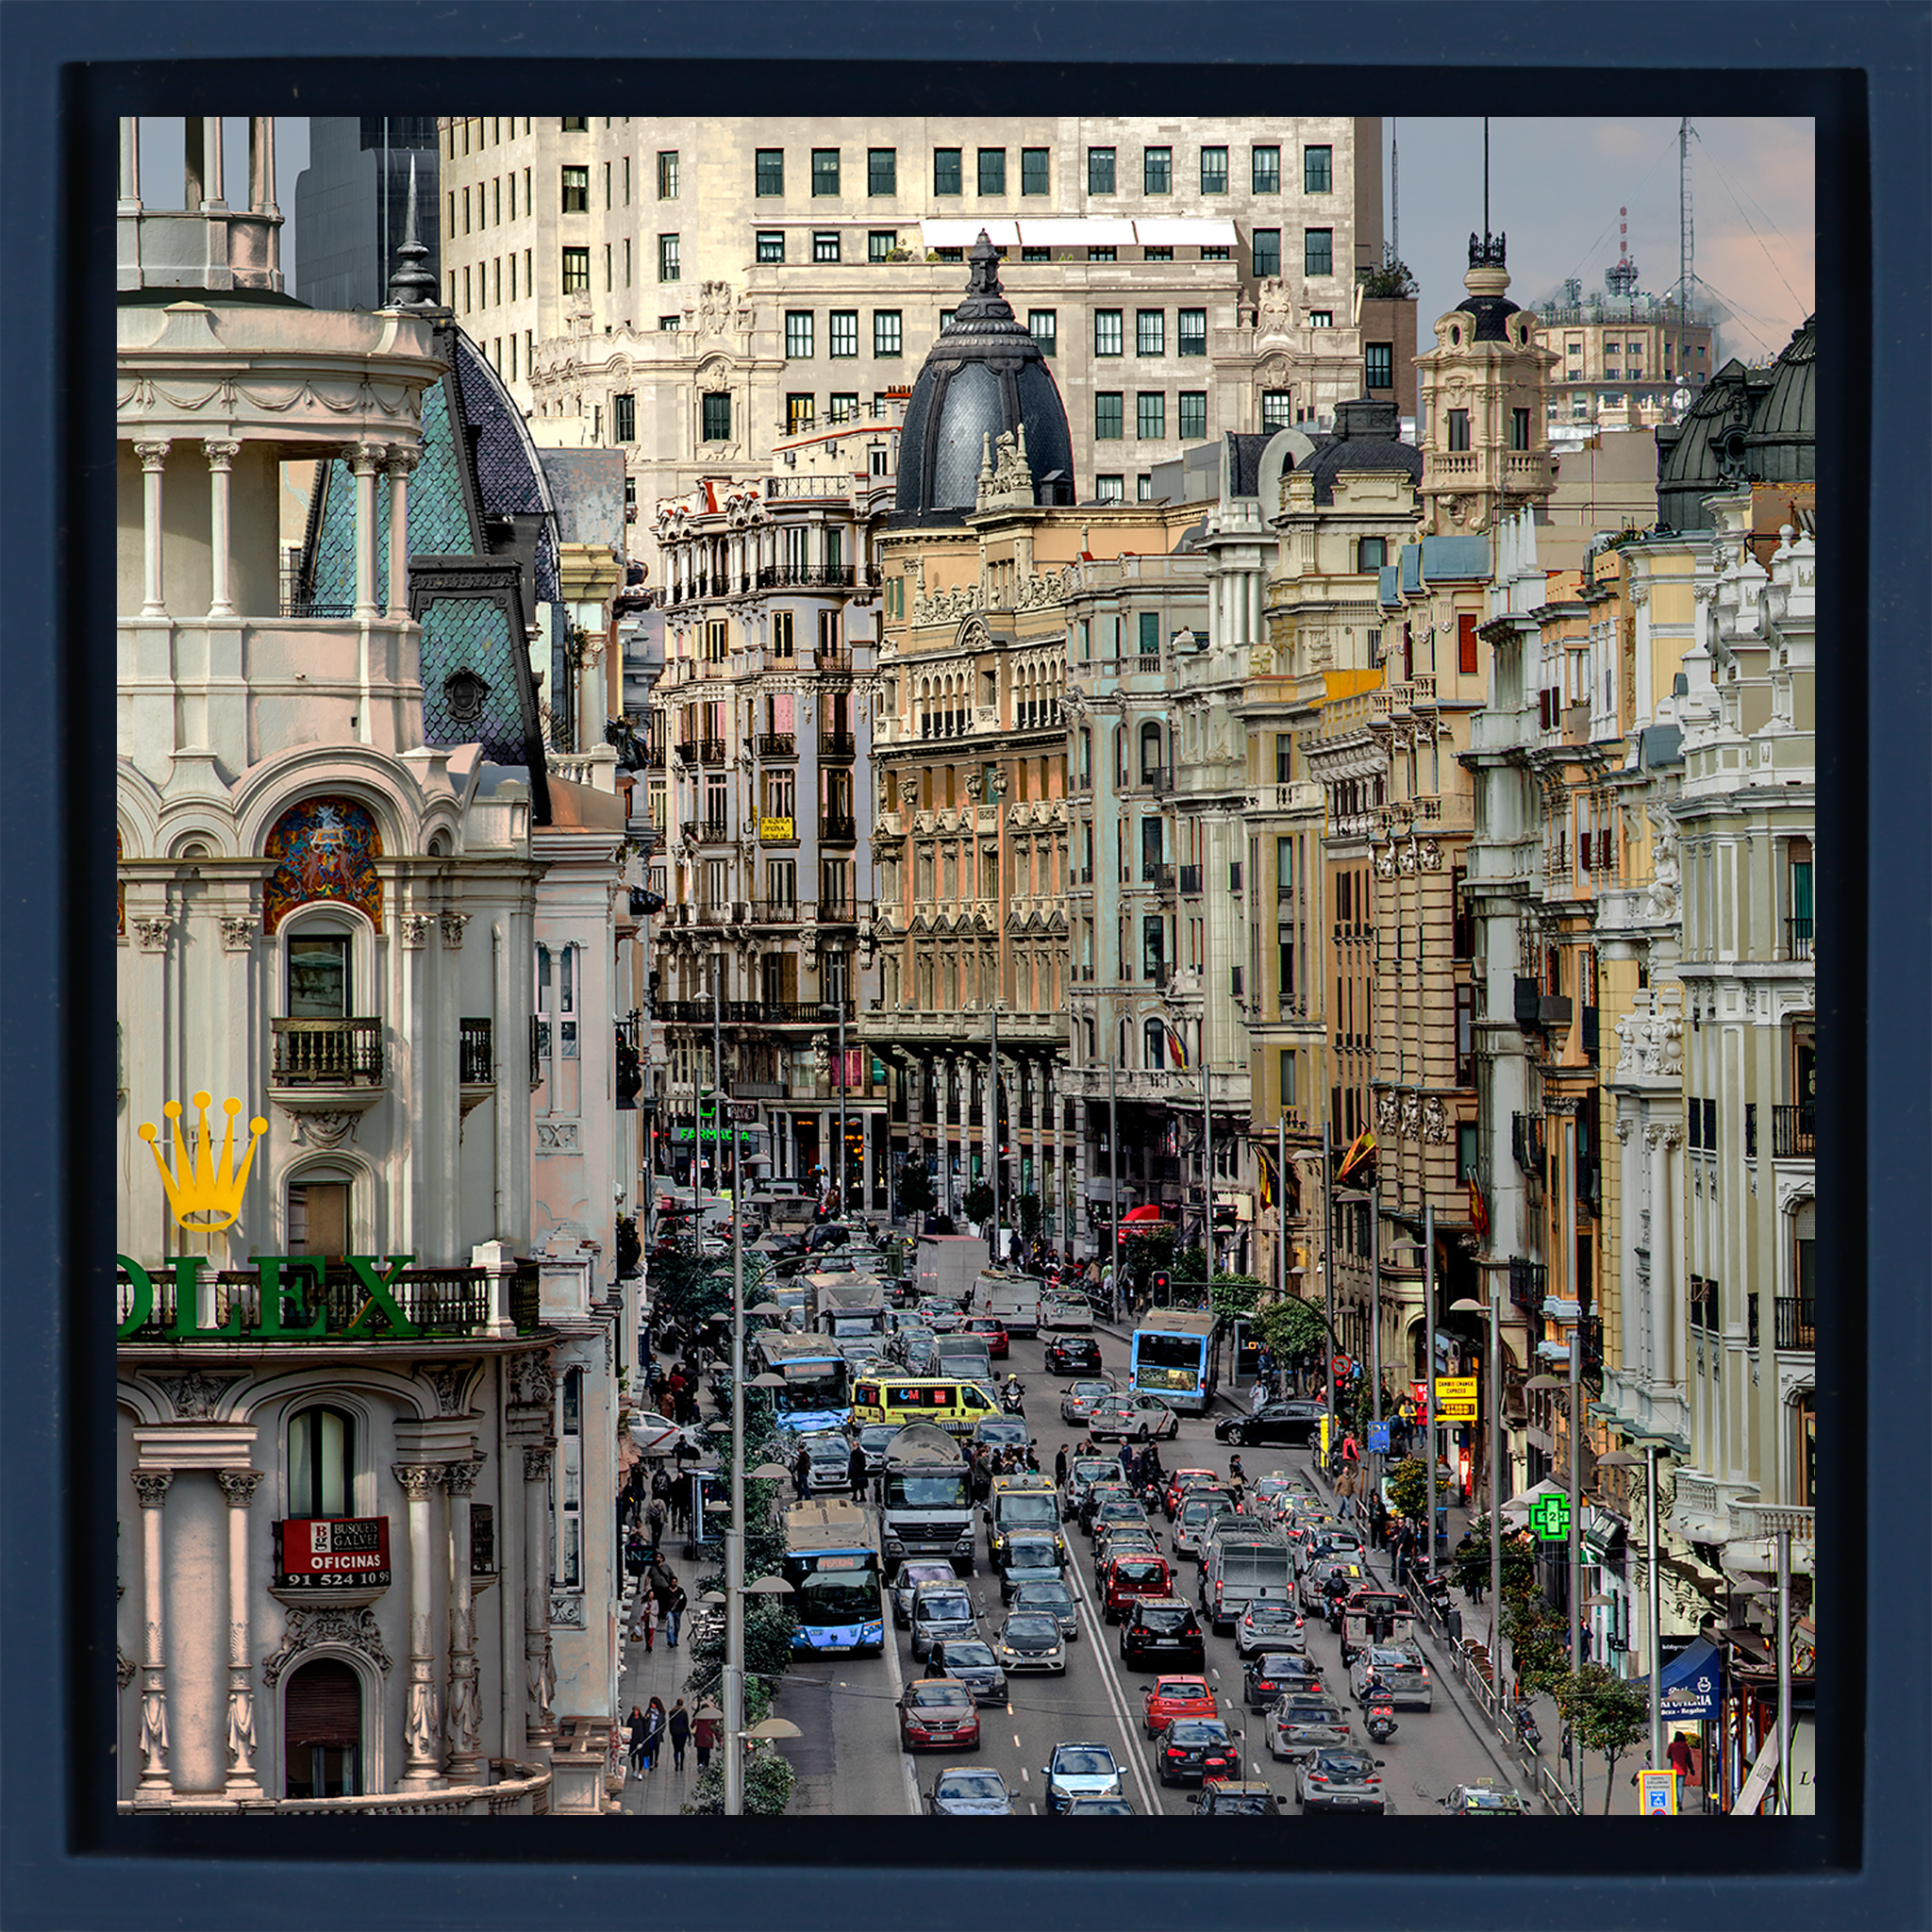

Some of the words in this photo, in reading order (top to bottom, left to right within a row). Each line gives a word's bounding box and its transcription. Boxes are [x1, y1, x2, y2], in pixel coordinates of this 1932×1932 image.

[680, 1129, 750, 1141] FARMACA
[334, 1523, 378, 1536] BUSQUETS
[334, 1534, 378, 1546] GALVEZ
[310, 1554, 381, 1569] OFICINAS
[289, 1574, 312, 1586] 91
[320, 1574, 354, 1586] 524
[360, 1572, 376, 1585] 10
[1799, 1770, 1816, 1786] L
